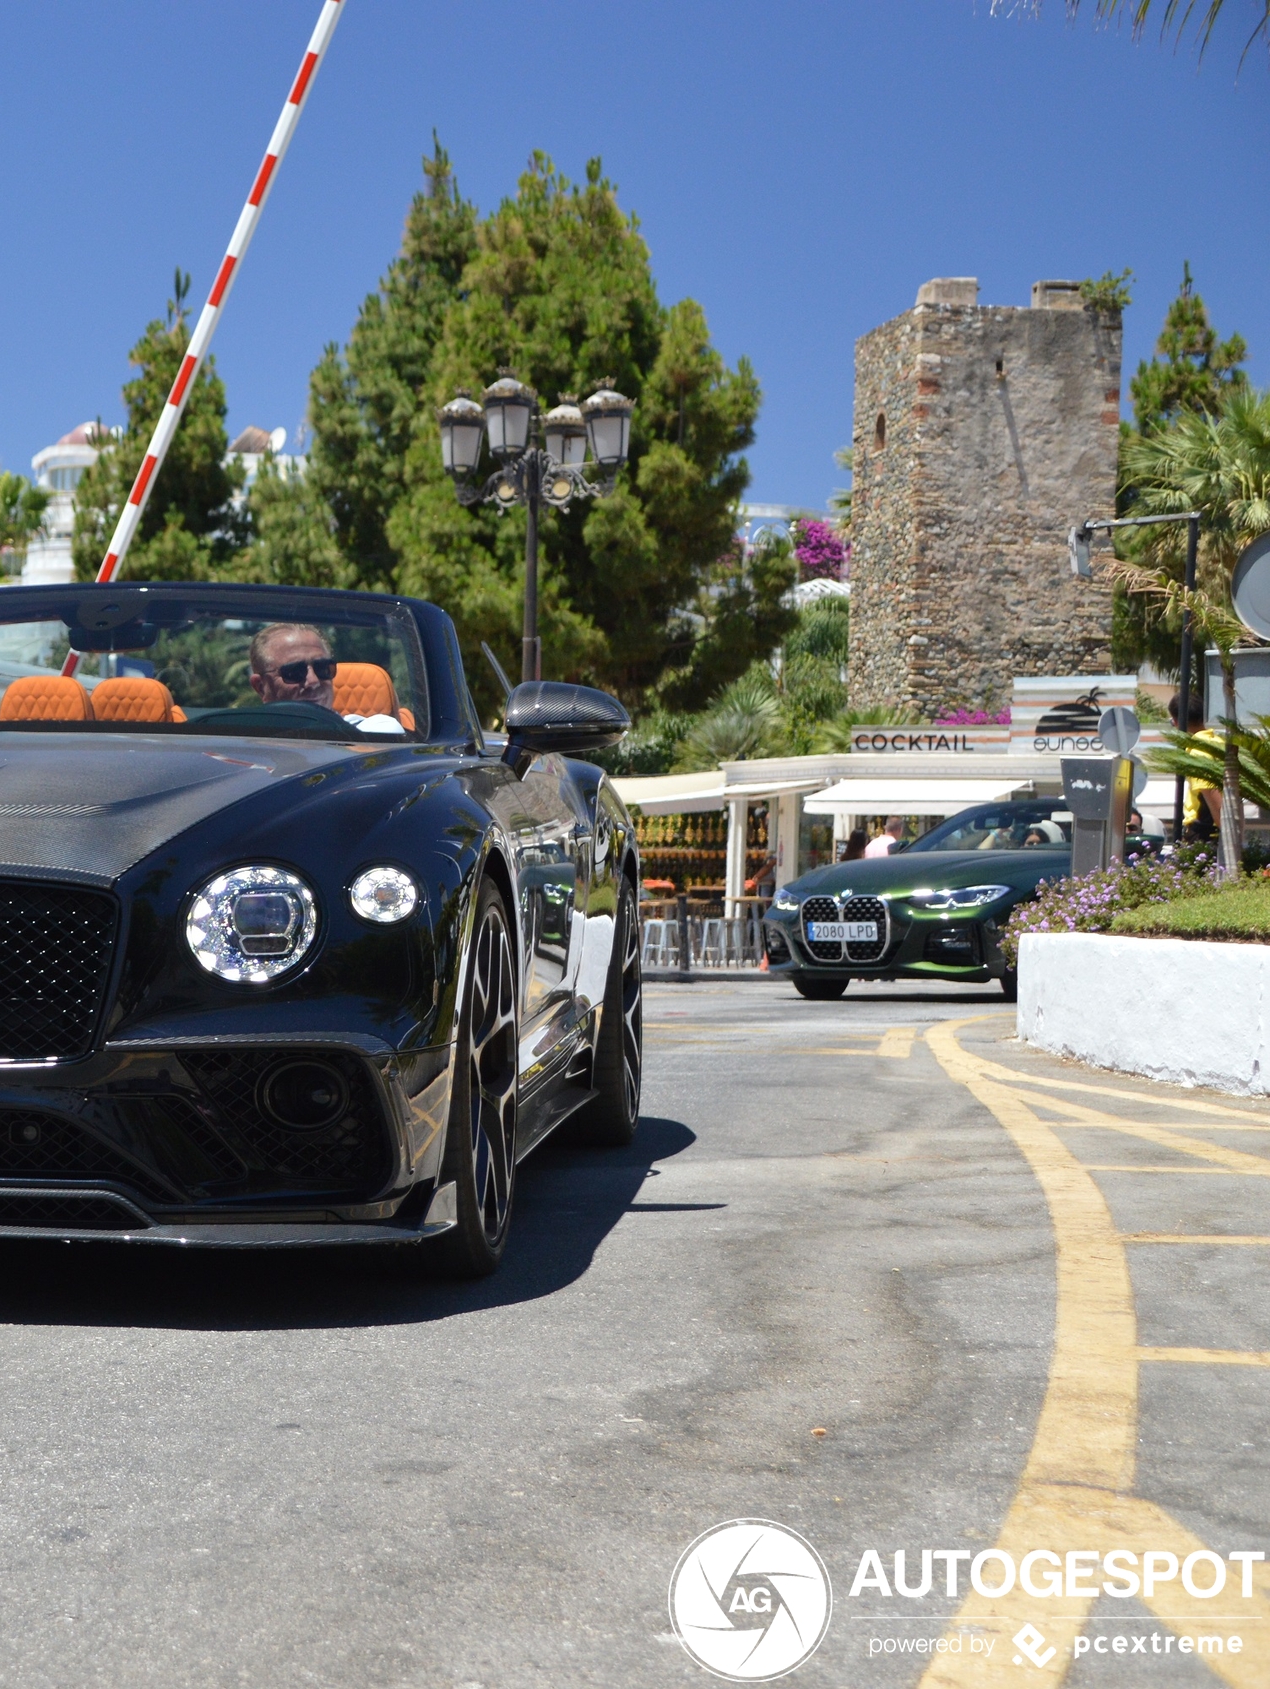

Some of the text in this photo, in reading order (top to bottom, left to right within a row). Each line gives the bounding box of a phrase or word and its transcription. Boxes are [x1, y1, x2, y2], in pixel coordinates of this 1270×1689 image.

[855, 733, 974, 751] COCKTAIL
[816, 925, 874, 938] 2080 LPD
